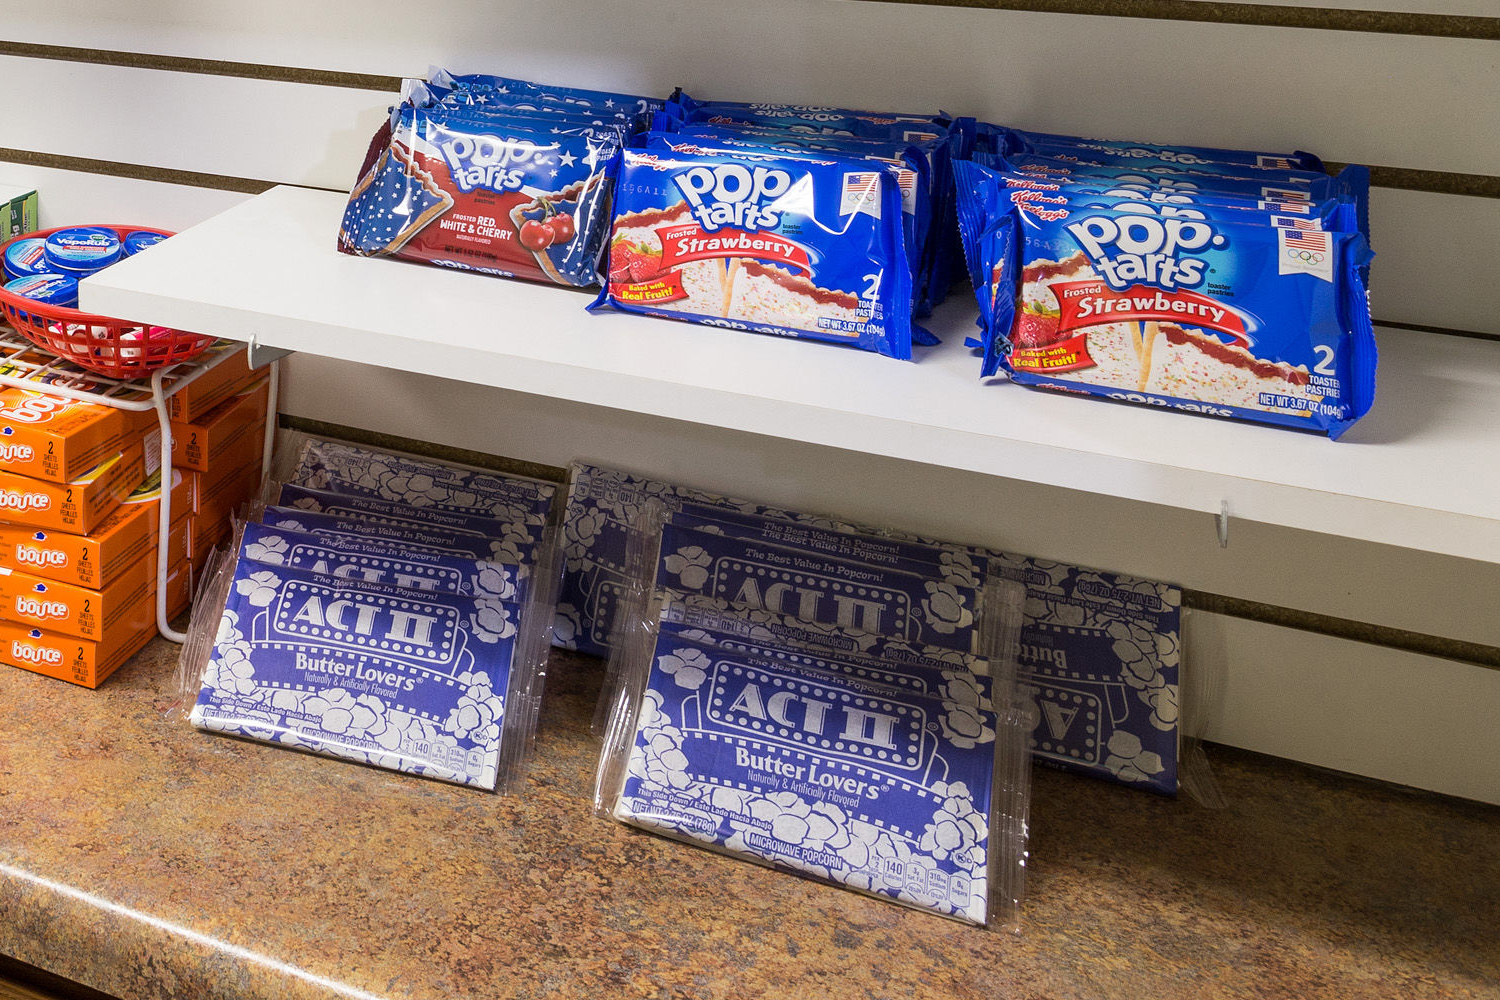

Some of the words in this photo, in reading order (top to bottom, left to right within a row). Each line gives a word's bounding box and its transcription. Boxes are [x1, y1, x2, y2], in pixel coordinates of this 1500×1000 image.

[440, 220, 466, 233] WHITE
[467, 224, 475, 233] &
[476, 225, 513, 241] CHERRY
[696, 203, 782, 233] tarts
[56, 237, 111, 247] VapoRub
[666, 228, 697, 240] Frosted
[676, 234, 795, 257] Strawberry
[1096, 251, 1206, 290] tarts
[1063, 285, 1102, 298] Frosted
[1076, 295, 1225, 324] Strawberry
[1013, 358, 1039, 368] Real
[1043, 353, 1077, 367] Fruit!
[1313, 344, 1336, 376] 2
[1306, 384, 1341, 399] PASTRIES
[1308, 374, 1341, 389] TOASTER
[1260, 393, 1275, 405] NET
[1276, 395, 1288, 407] WT
[1289, 396, 1306, 410] 3.67
[1308, 401, 1319, 412] OZ
[1320, 404, 1343, 420] (104g)
[314, 574, 330, 583] The
[333, 577, 354, 588] Best
[356, 582, 380, 592] Value
[382, 585, 393, 594] In
[395, 587, 438, 602] Popcorn!
[293, 595, 382, 637] ACT
[385, 607, 437, 648] II
[296, 652, 353, 677] Butter
[728, 684, 833, 735] ACT
[838, 704, 900, 750] II
[735, 746, 807, 781] Butter
[747, 769, 780, 791] Naturally
[782, 777, 789, 789] &
[790, 777, 827, 800] Artificially
[827, 788, 860, 809] Flavored
[750, 832, 801, 860] MICROWAVE
[801, 848, 843, 870] POPCORN
